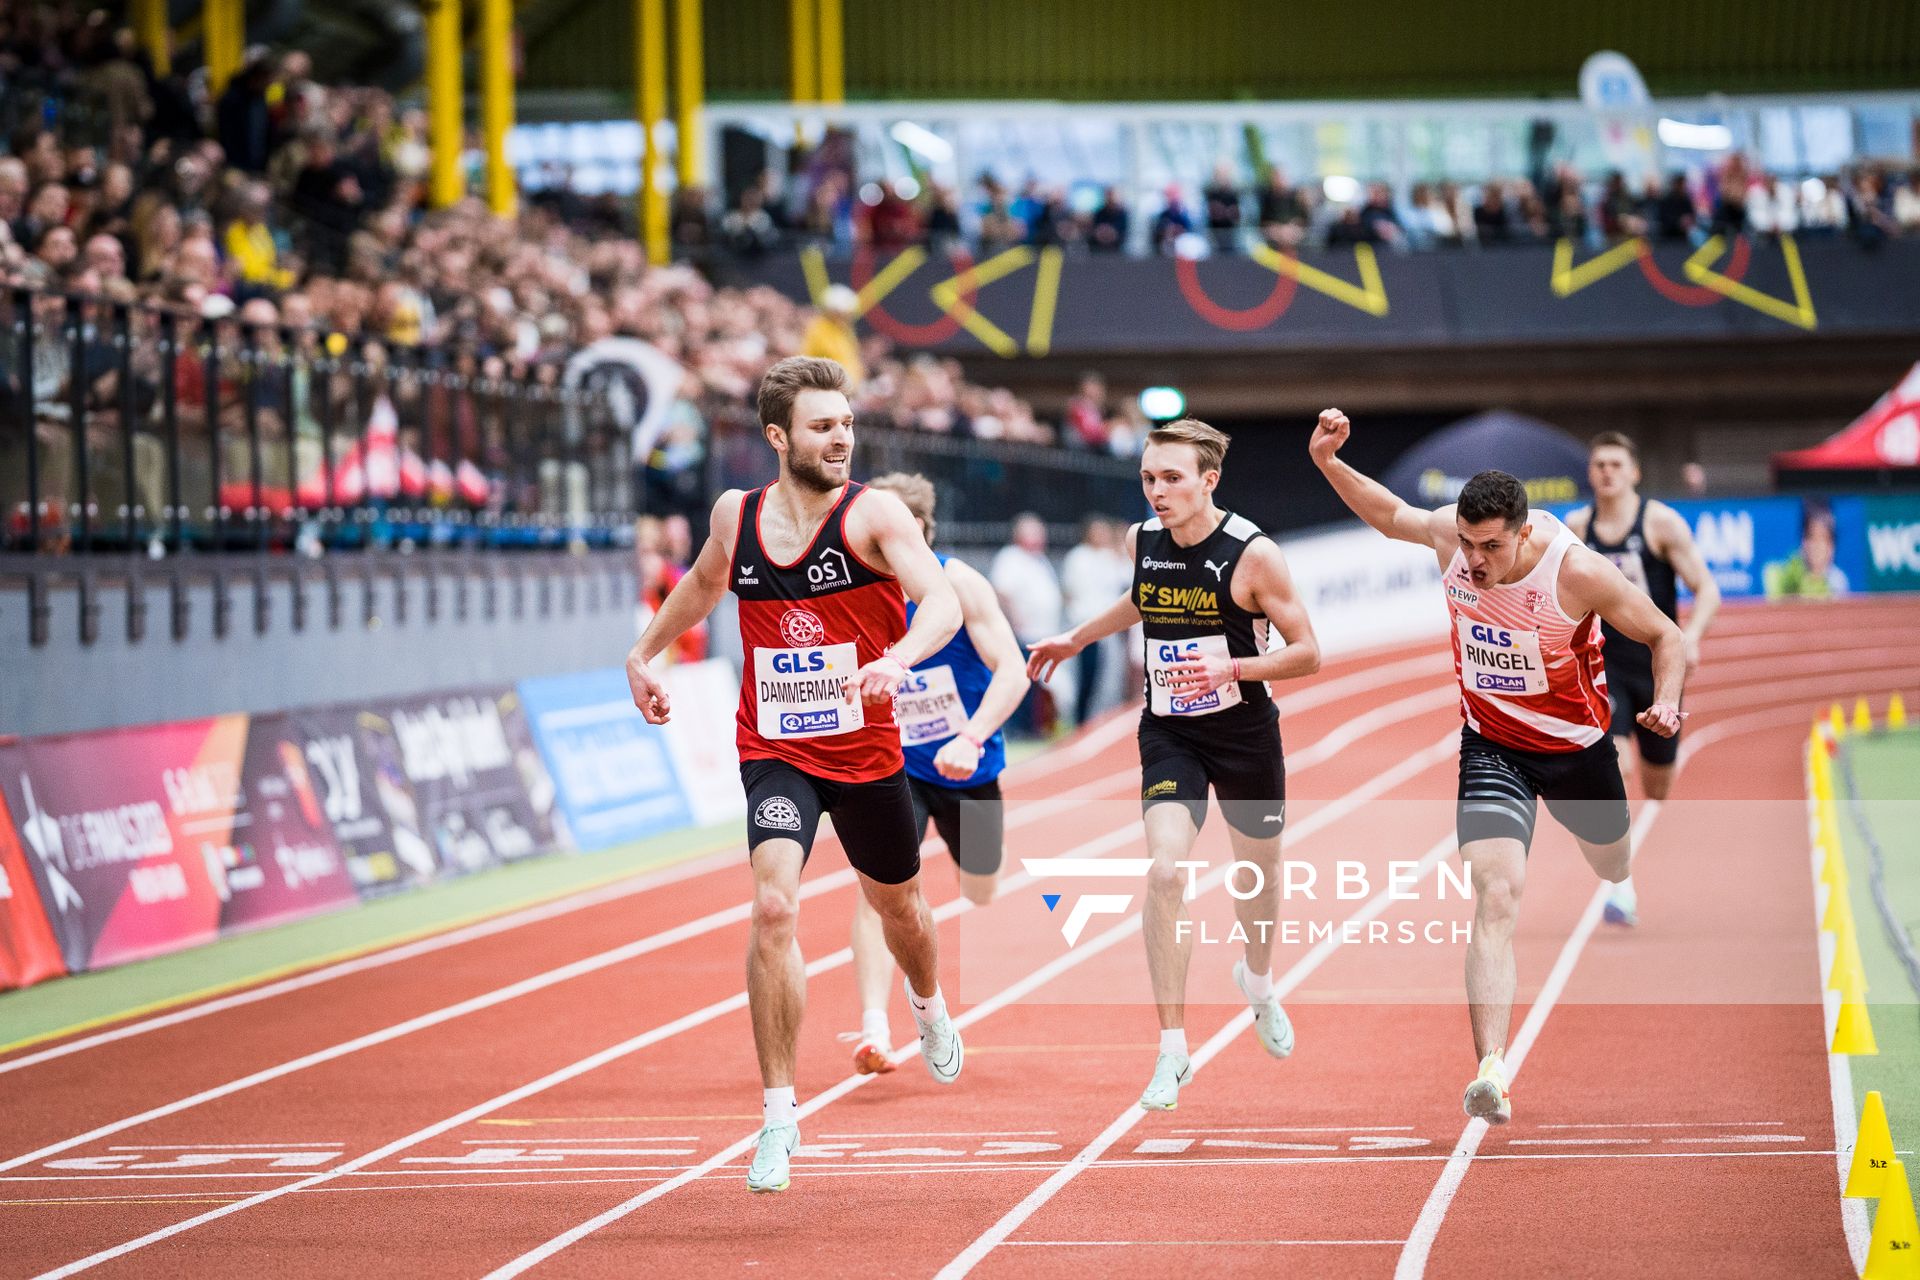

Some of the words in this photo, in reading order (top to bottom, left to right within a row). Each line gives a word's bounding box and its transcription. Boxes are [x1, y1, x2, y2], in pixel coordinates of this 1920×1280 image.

[807, 562, 837, 583] OS
[738, 577, 759, 585] erima
[1458, 590, 1478, 603] EWP
[1466, 643, 1535, 671] RINGEL
[1496, 679, 1523, 687] PLAN
[761, 676, 852, 704] DAMMERMAN
[803, 713, 836, 726] PLAN
